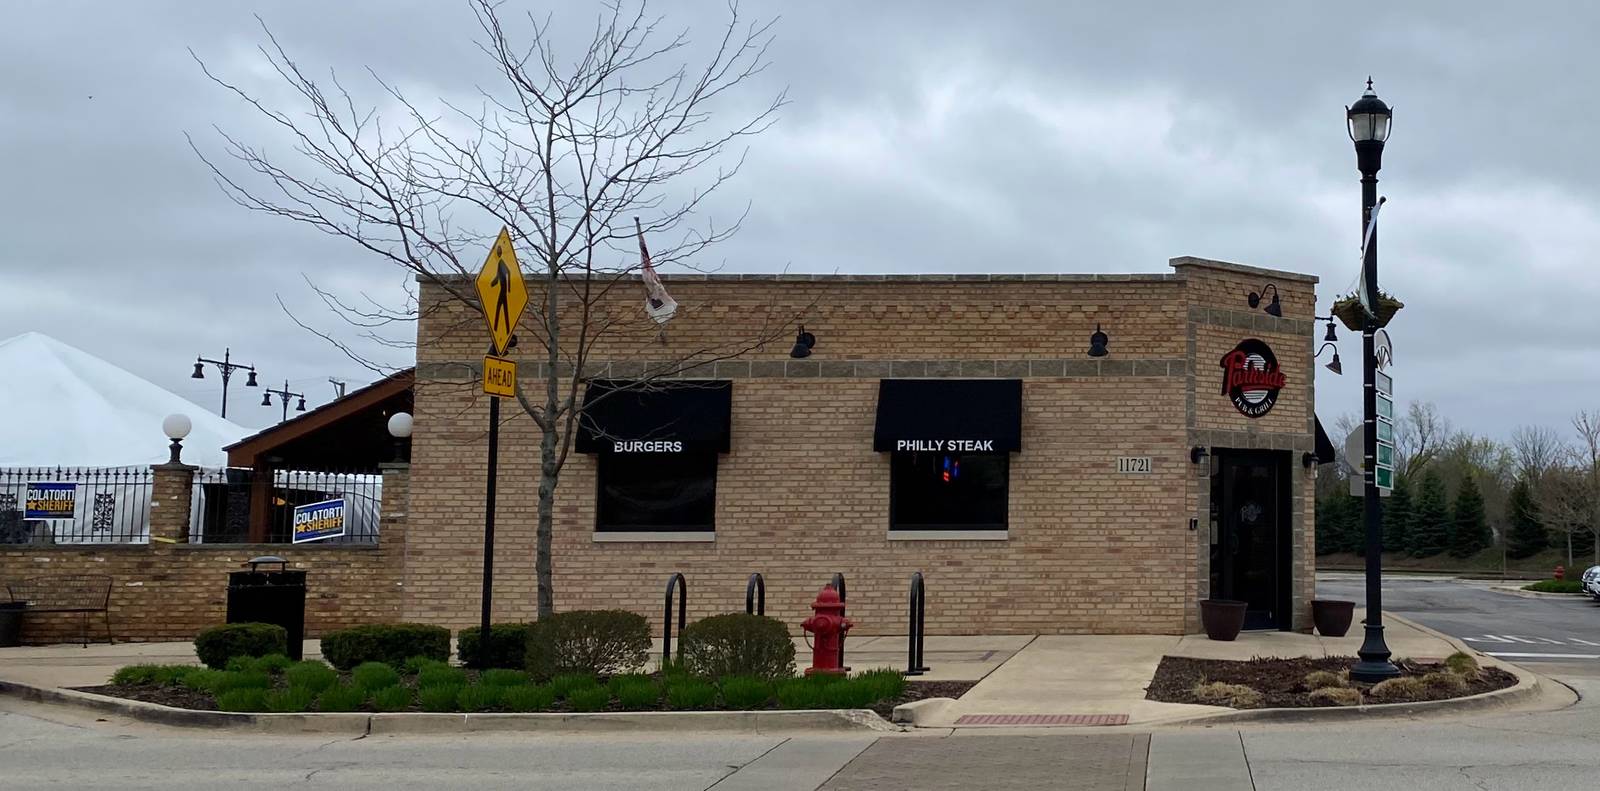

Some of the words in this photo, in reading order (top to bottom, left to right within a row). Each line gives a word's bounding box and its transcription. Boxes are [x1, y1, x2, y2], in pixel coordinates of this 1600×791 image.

[487, 367, 513, 387] AHEAD
[1223, 351, 1286, 394] Parkside
[1235, 397, 1248, 412] PUB
[1247, 407, 1254, 415] &
[1254, 398, 1273, 414] GRILL
[614, 441, 682, 453] BURGERS
[897, 440, 944, 451] PHILLY
[947, 440, 993, 451] STEAK
[1119, 458, 1149, 472] 11721
[27, 489, 75, 500] COLATORTI
[37, 500, 74, 511] SHERIFF
[296, 506, 343, 525] COLATORTI
[306, 516, 343, 531] SHERIFF
